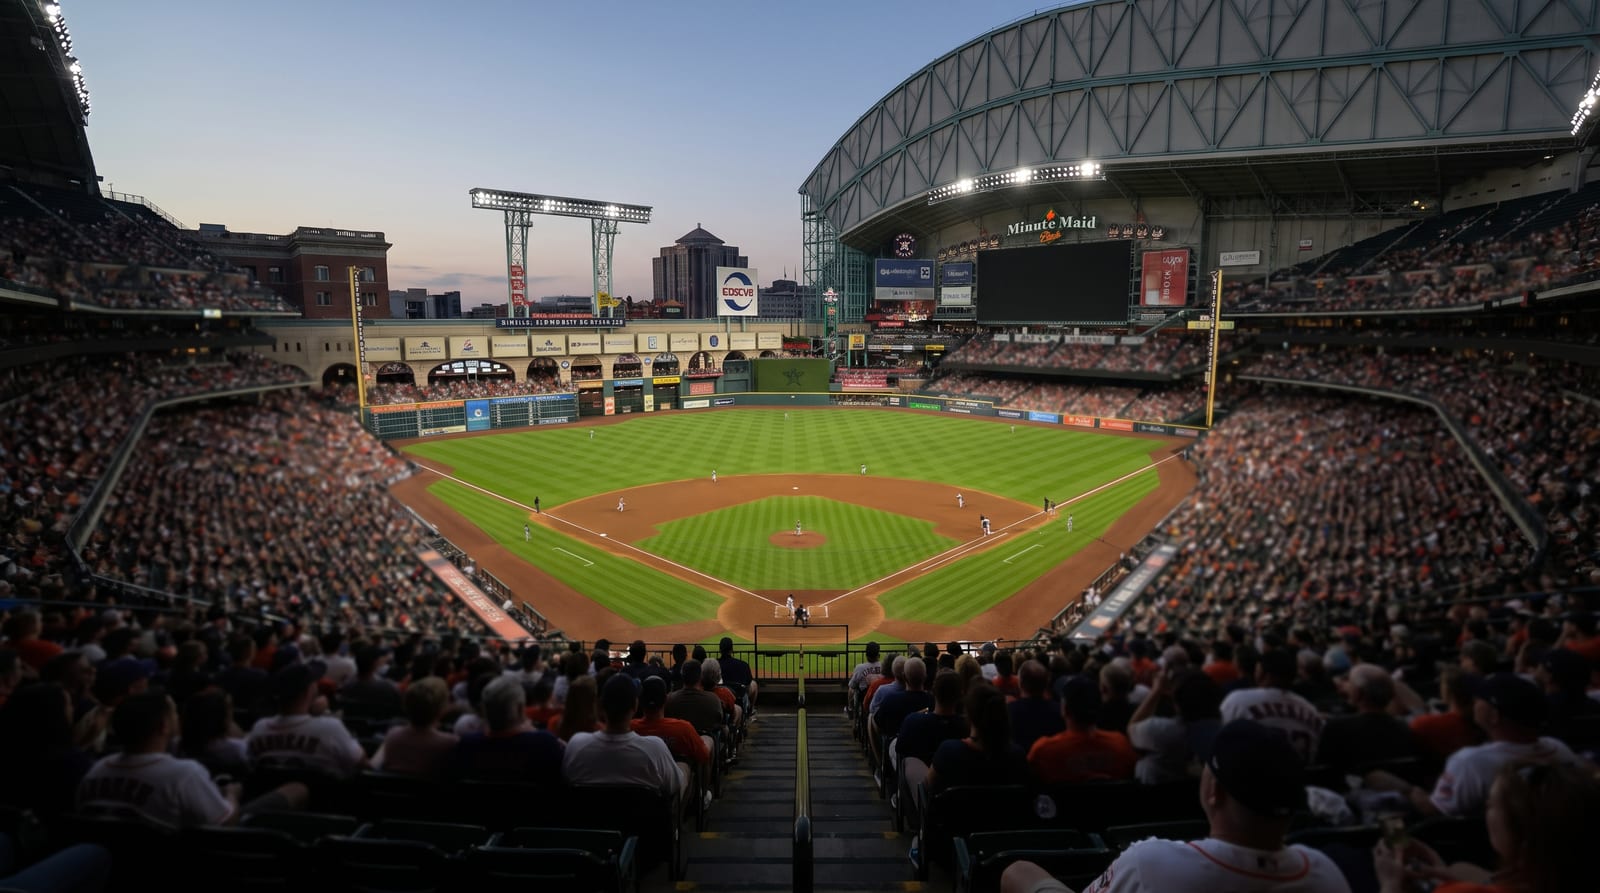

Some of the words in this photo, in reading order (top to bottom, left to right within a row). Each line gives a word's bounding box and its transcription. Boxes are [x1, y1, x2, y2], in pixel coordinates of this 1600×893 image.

[1006, 219, 1056, 237] Minute
[1059, 215, 1097, 229] Maid
[722, 287, 754, 297] EDSCVB
